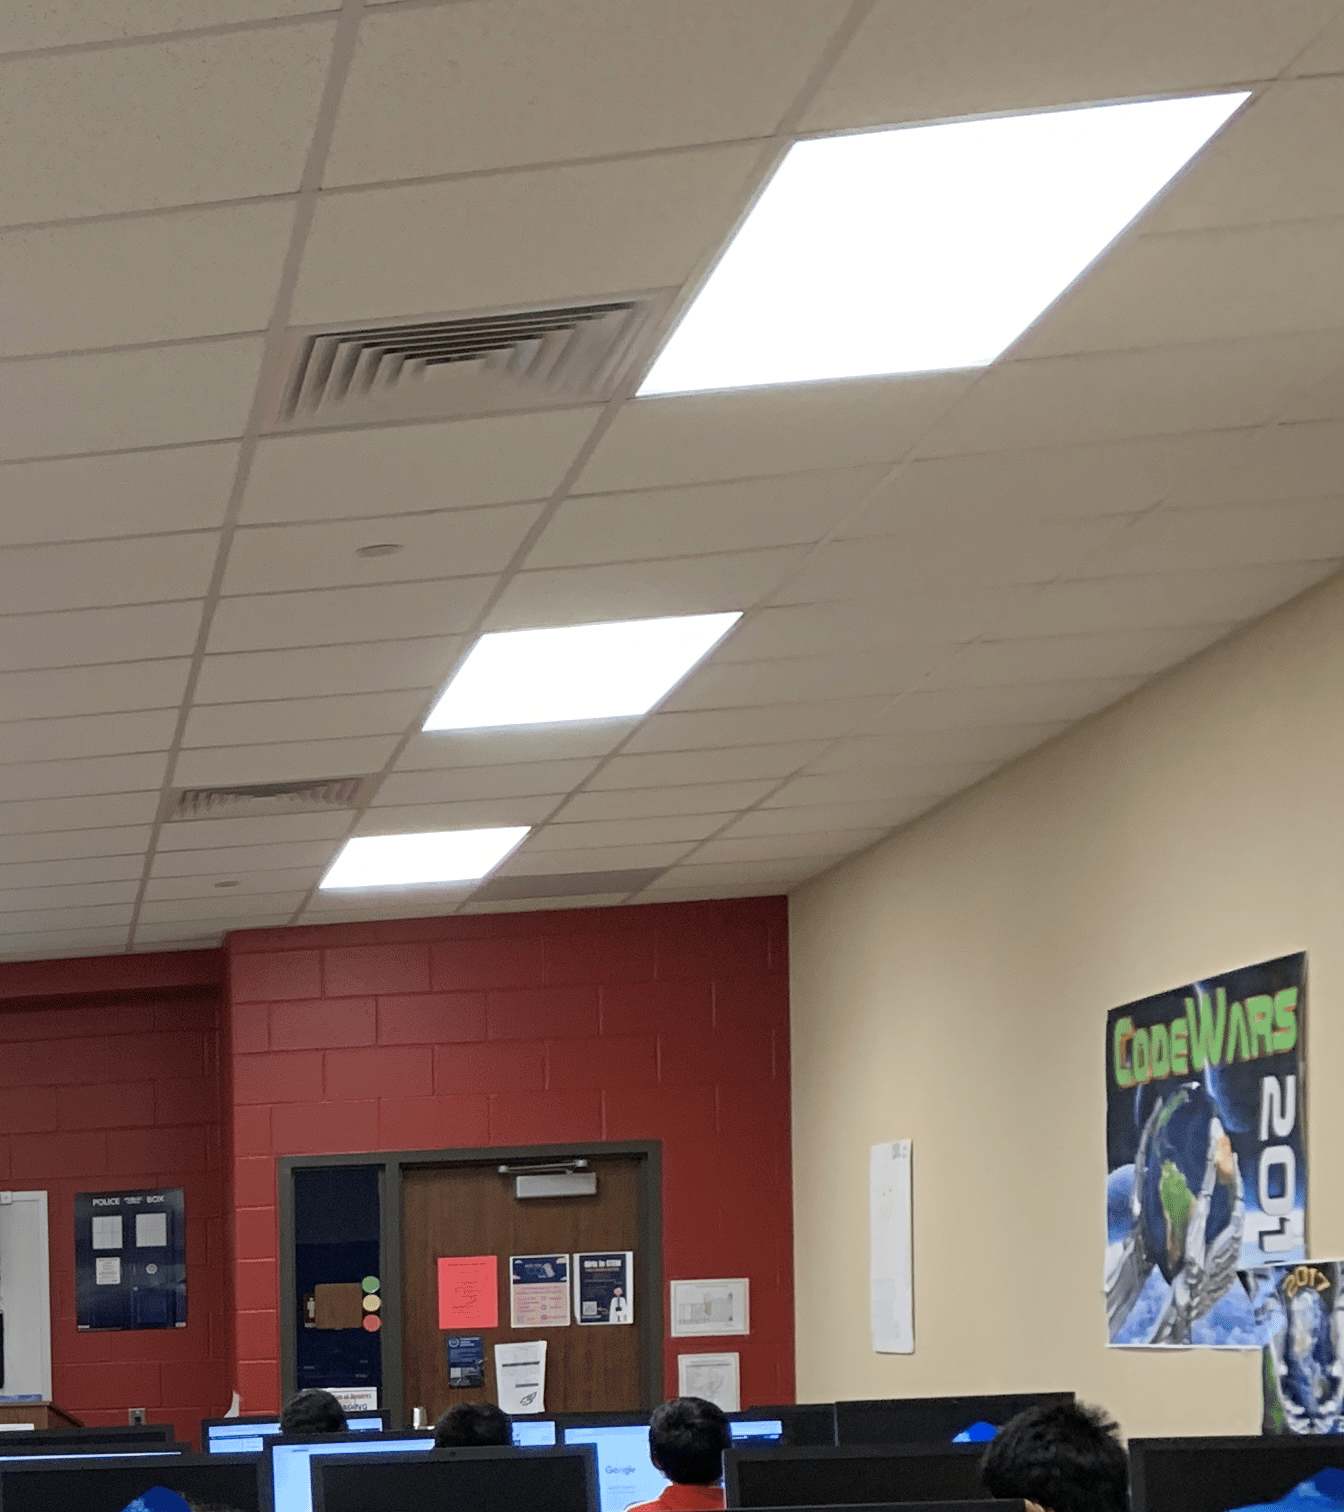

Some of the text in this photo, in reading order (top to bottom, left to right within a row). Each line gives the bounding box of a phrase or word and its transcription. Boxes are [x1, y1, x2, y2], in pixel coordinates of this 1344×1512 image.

[1258, 1074, 1297, 1264] 201
[93, 1197, 120, 1206] POLICE
[146, 1195, 164, 1203] BOX
[605, 1465, 636, 1476] Google
